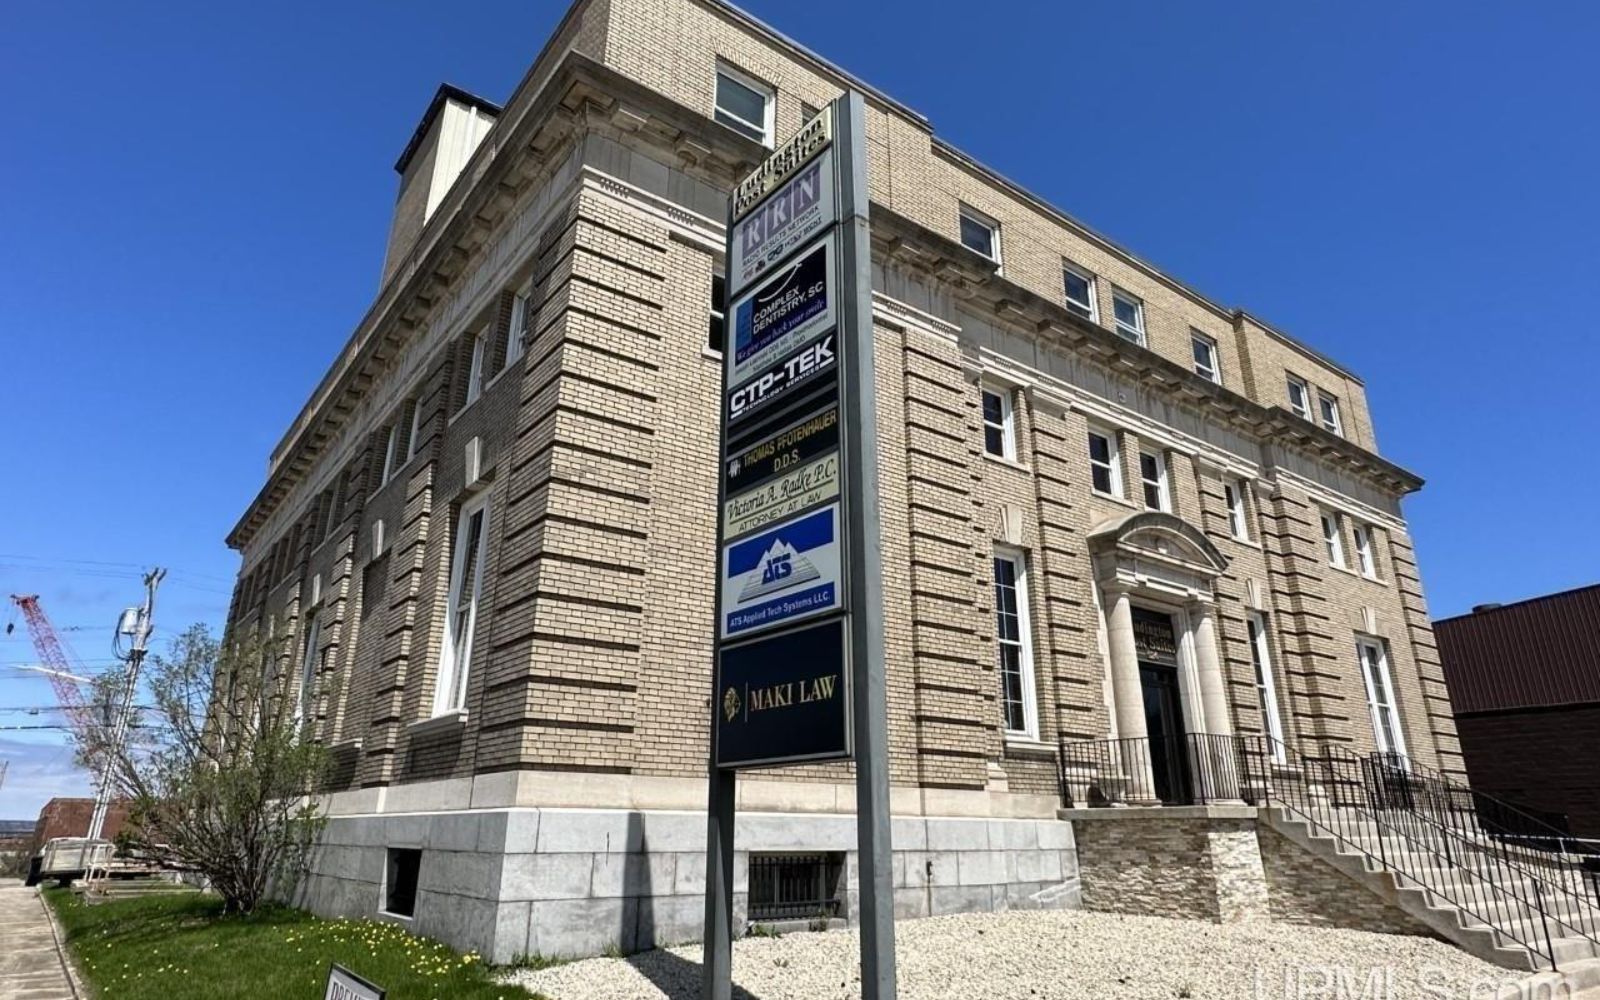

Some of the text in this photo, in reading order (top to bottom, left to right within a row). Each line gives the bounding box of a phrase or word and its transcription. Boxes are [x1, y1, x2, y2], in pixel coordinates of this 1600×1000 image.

[735, 131, 825, 216] Post Suites
[737, 119, 822, 198] Ludington
[753, 281, 824, 335] DENTISTRY, SC
[754, 285, 799, 324] COMPLEX
[730, 335, 834, 412] CTP-TEK
[743, 364, 820, 412] TECHNOLOGY SERVICES
[744, 410, 836, 467] THOMAS PFOTENHAUER
[774, 448, 801, 472] D.D.S.
[728, 458, 837, 520] Victoria A. Radke P.C.
[739, 491, 822, 532] ATTORNEY AT LAW
[761, 552, 792, 585] ATS
[729, 616, 742, 627] ATS
[743, 608, 766, 625] Applied
[767, 606, 782, 617] Tech
[783, 596, 812, 613] Systems
[750, 674, 838, 712] MAKI LAW
